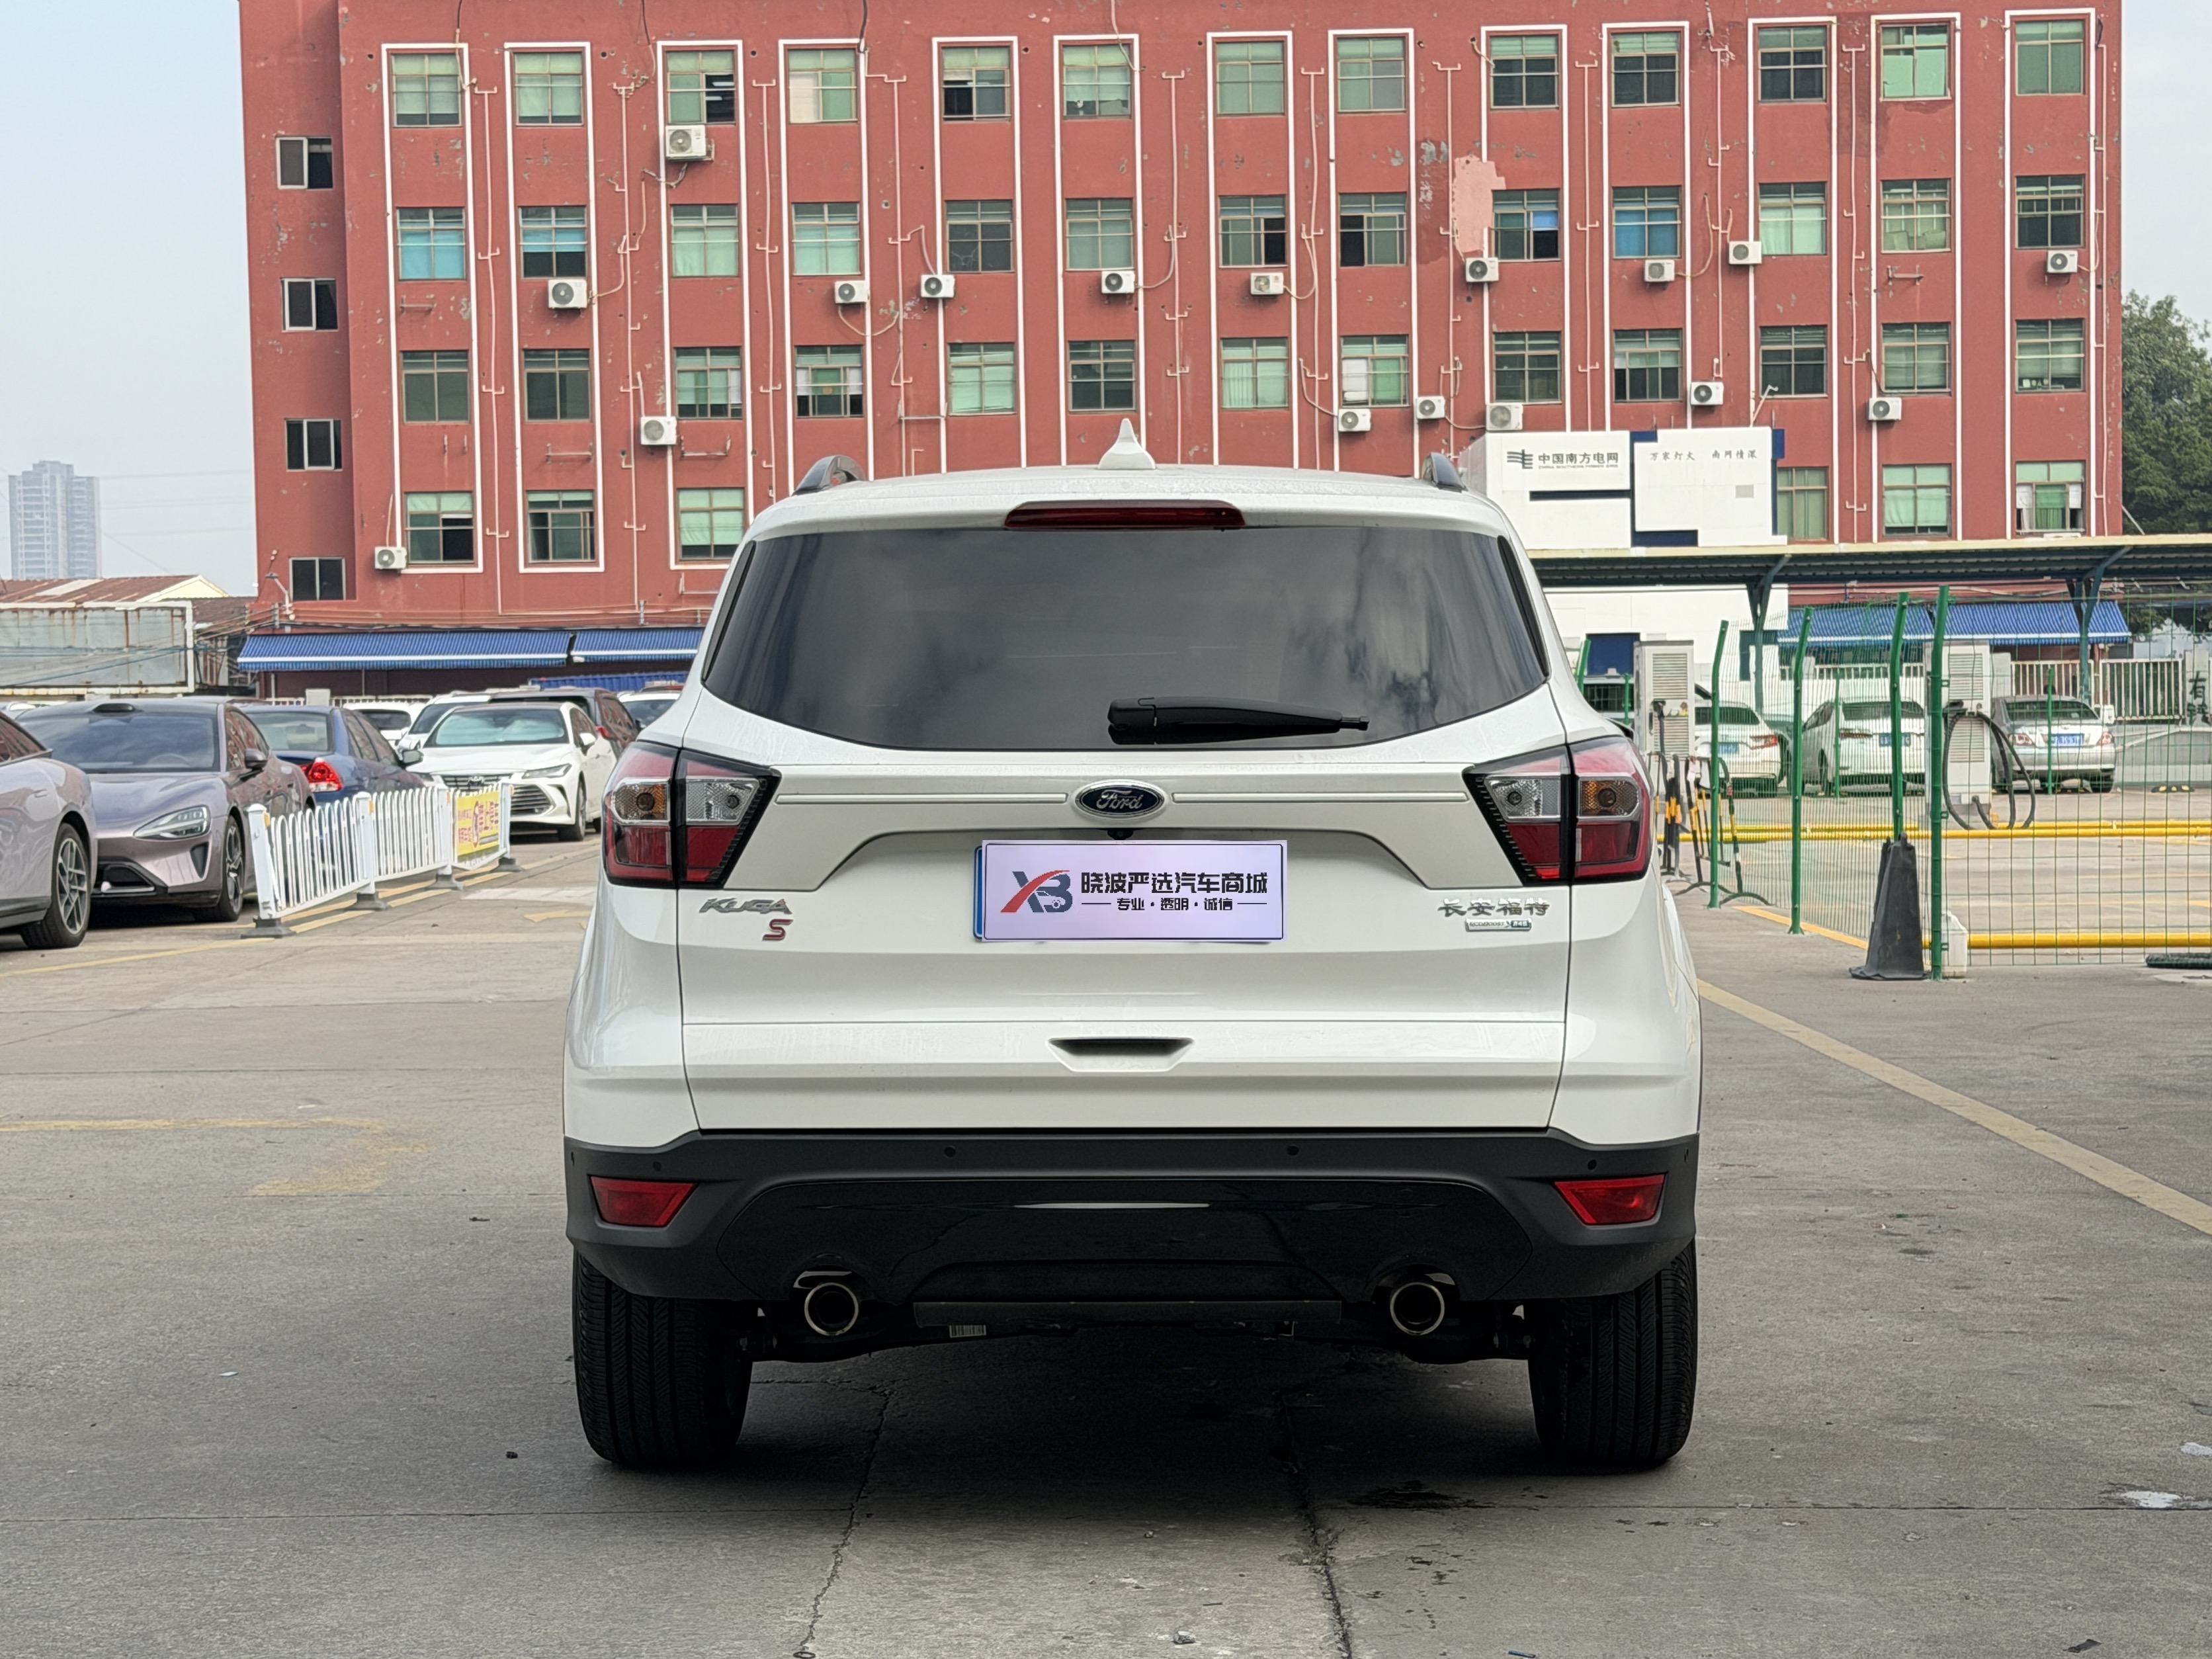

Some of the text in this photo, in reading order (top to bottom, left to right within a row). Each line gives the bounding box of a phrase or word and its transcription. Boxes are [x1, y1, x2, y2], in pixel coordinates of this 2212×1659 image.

[1538, 452, 1619, 464] 中国南方电网
[1096, 789, 1144, 809] Ford
[1082, 872, 1267, 894] 晓波严选汽车商城
[699, 898, 792, 915] KUGA
[1437, 898, 1550, 917] 长安福特
[762, 919, 794, 941] S
